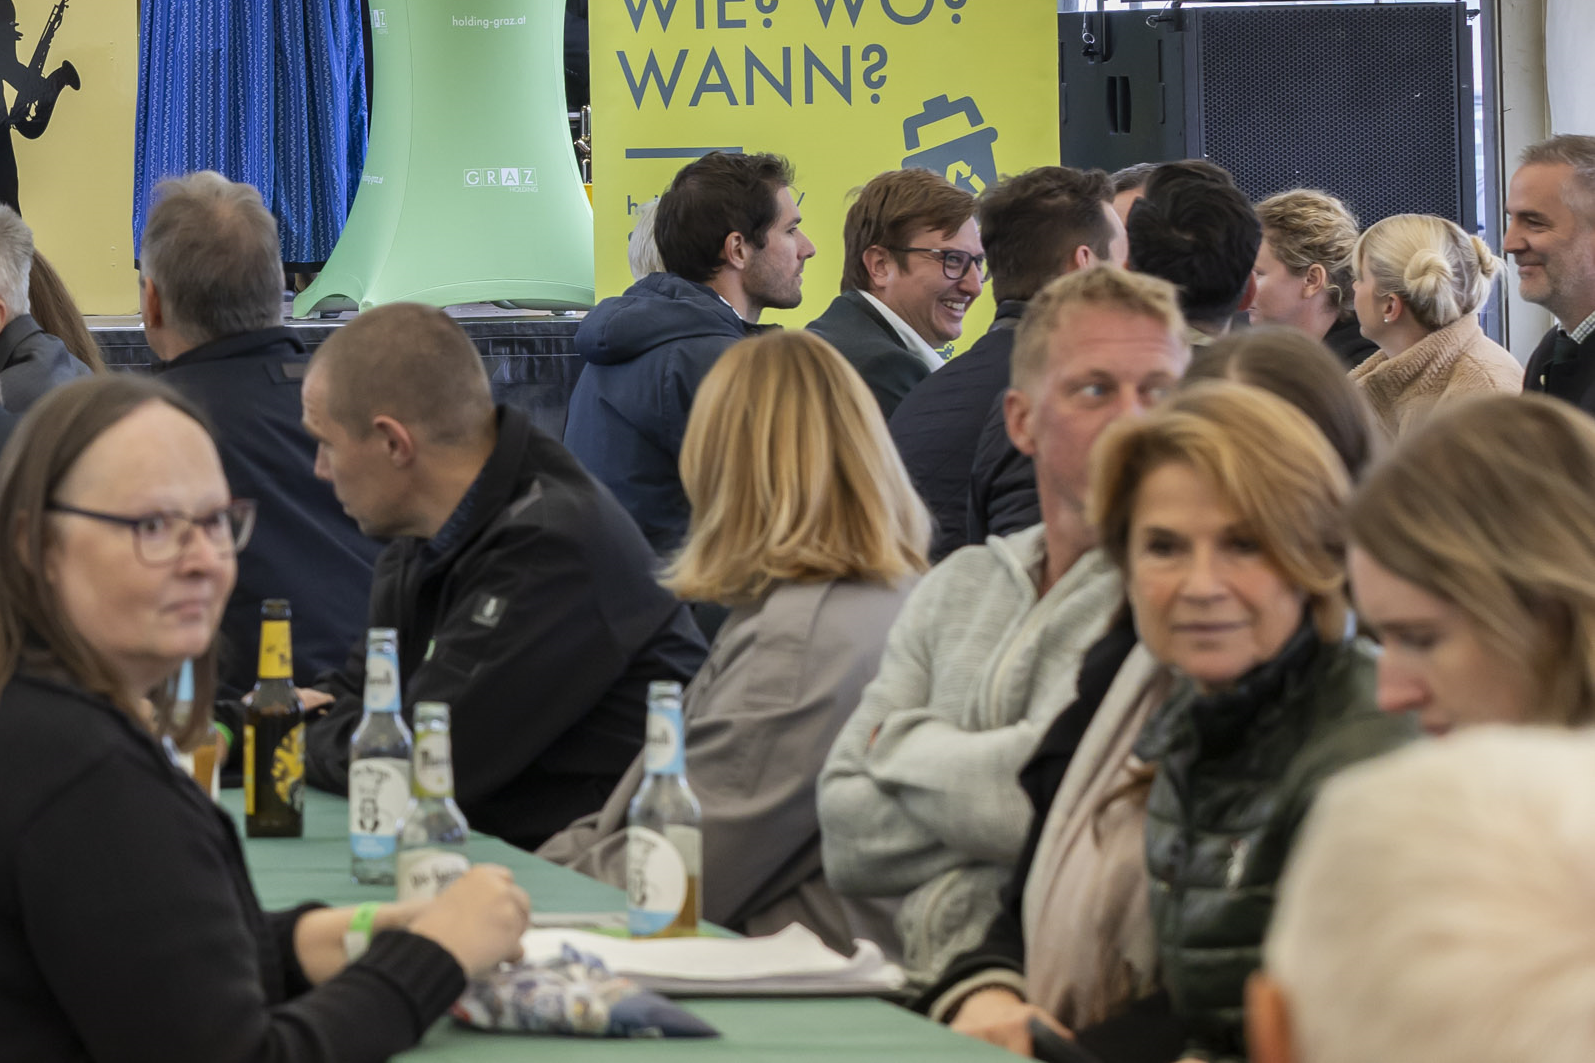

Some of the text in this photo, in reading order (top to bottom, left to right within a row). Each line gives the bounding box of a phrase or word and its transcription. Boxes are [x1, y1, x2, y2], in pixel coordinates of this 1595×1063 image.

[452, 15, 527, 29] holding-graz.at
[616, 43, 888, 110] WANN?
[463, 167, 537, 187] GRAZ
